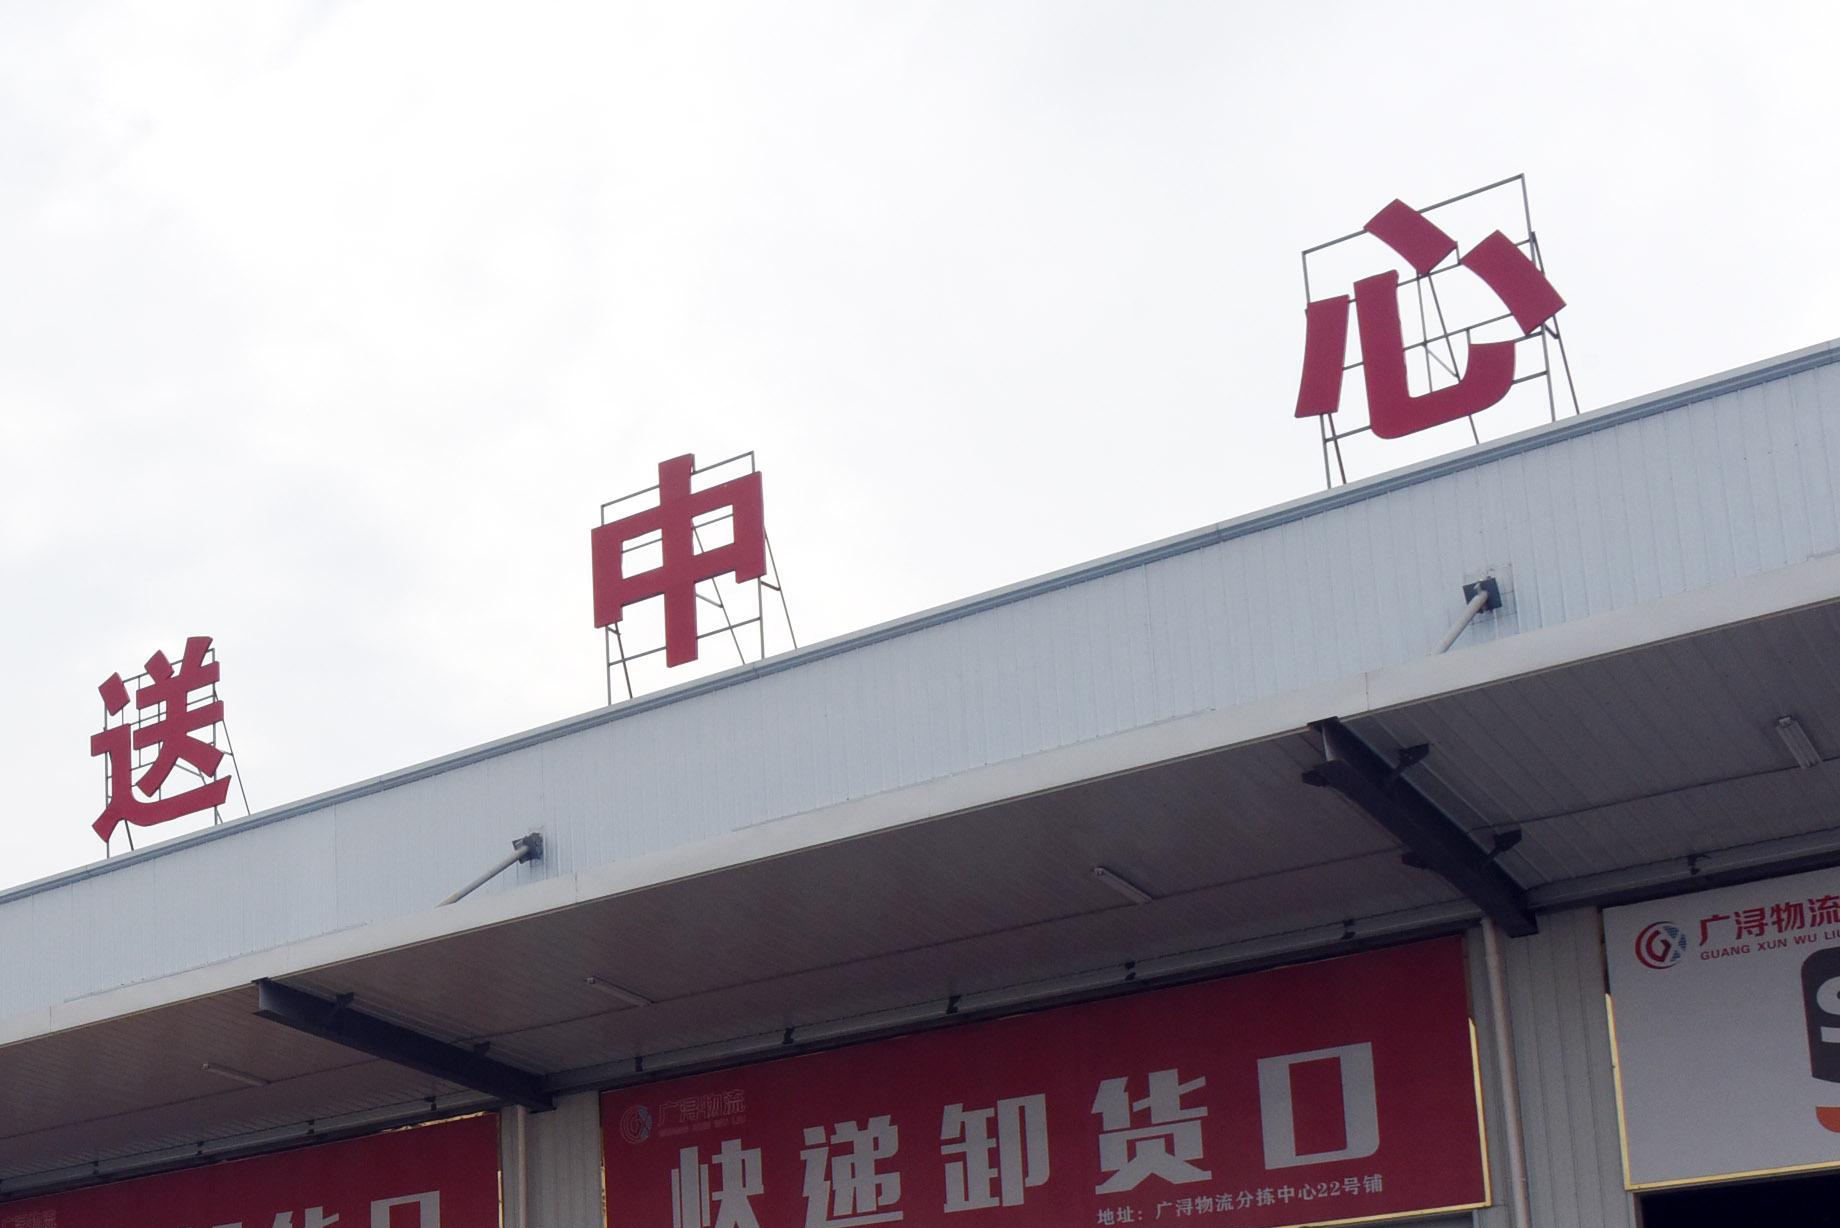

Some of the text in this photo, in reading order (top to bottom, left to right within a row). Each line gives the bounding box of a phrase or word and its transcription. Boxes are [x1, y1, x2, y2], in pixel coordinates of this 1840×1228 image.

[1700, 895, 1840, 946] 广浔物流
[1701, 944, 1750, 960] GUANG
[1758, 938, 1787, 952] XUN
[1794, 932, 1817, 945] WU
